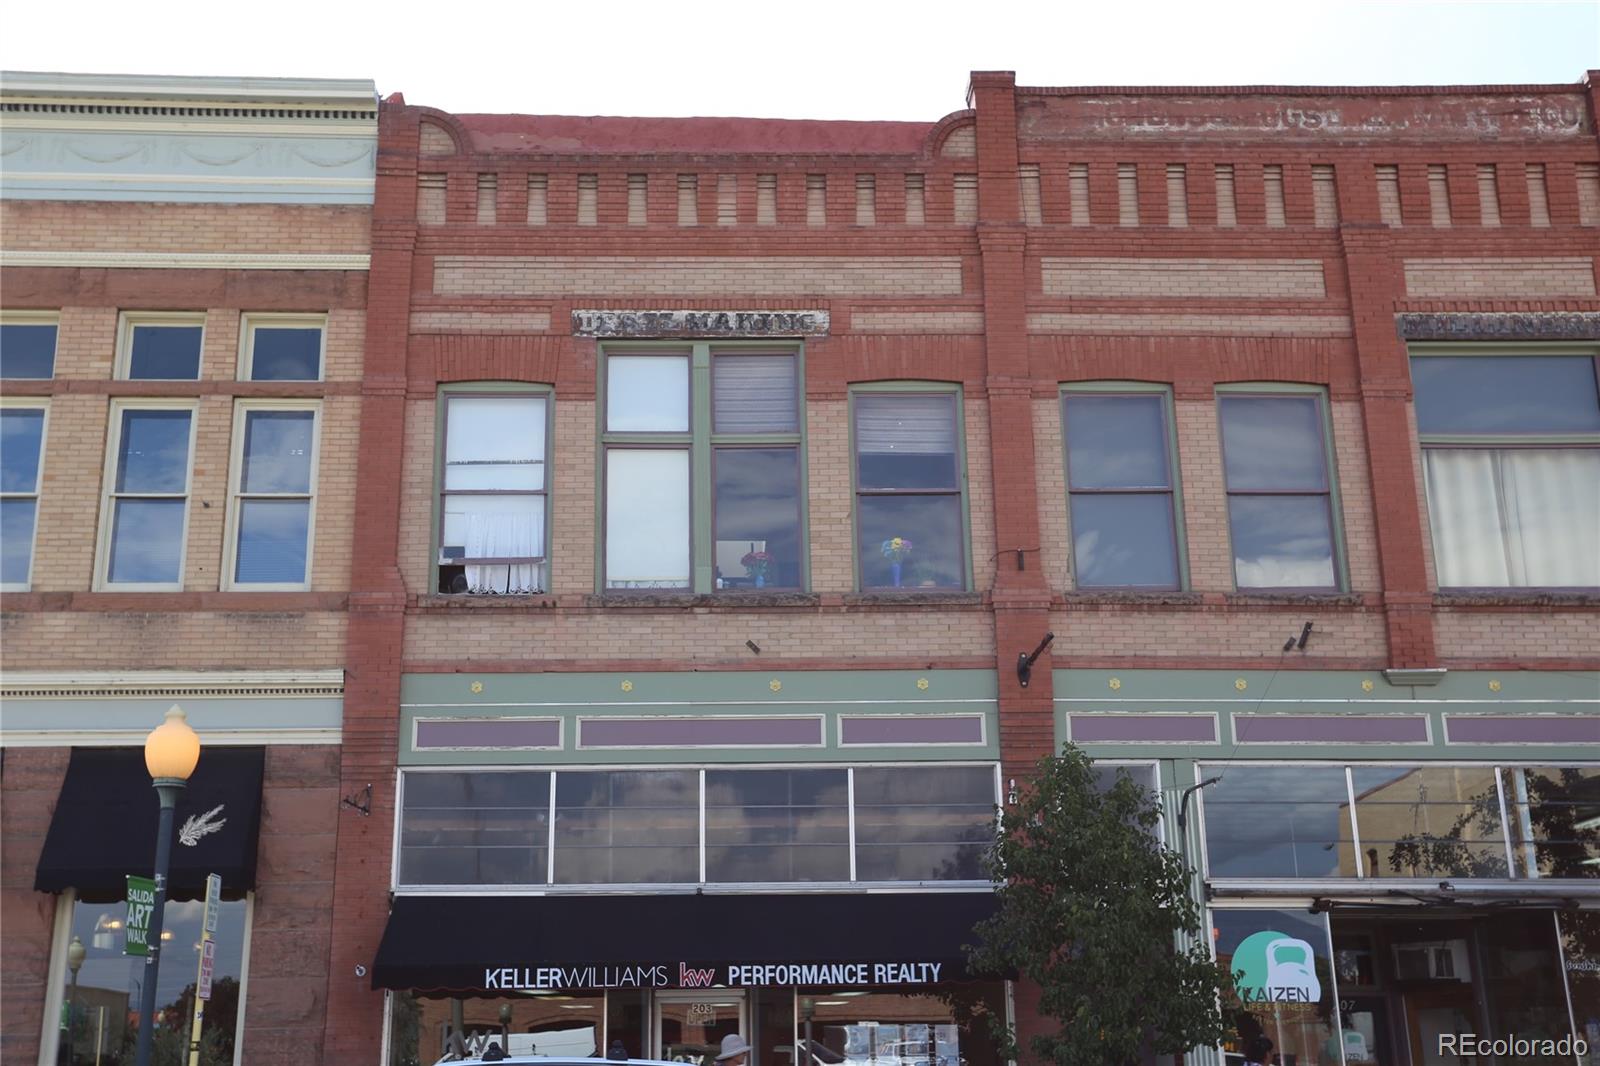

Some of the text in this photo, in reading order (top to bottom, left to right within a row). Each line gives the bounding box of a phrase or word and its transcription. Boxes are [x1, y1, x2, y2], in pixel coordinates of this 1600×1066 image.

[128, 888, 155, 904] SALIDA
[126, 903, 154, 929] ART
[127, 927, 148, 944] WALK
[679, 961, 716, 988] kw
[728, 963, 869, 986] PERFORMANCE
[874, 962, 942, 984] REALTY
[1242, 986, 1310, 1002] KAIZEN
[692, 1003, 712, 1013] 203
